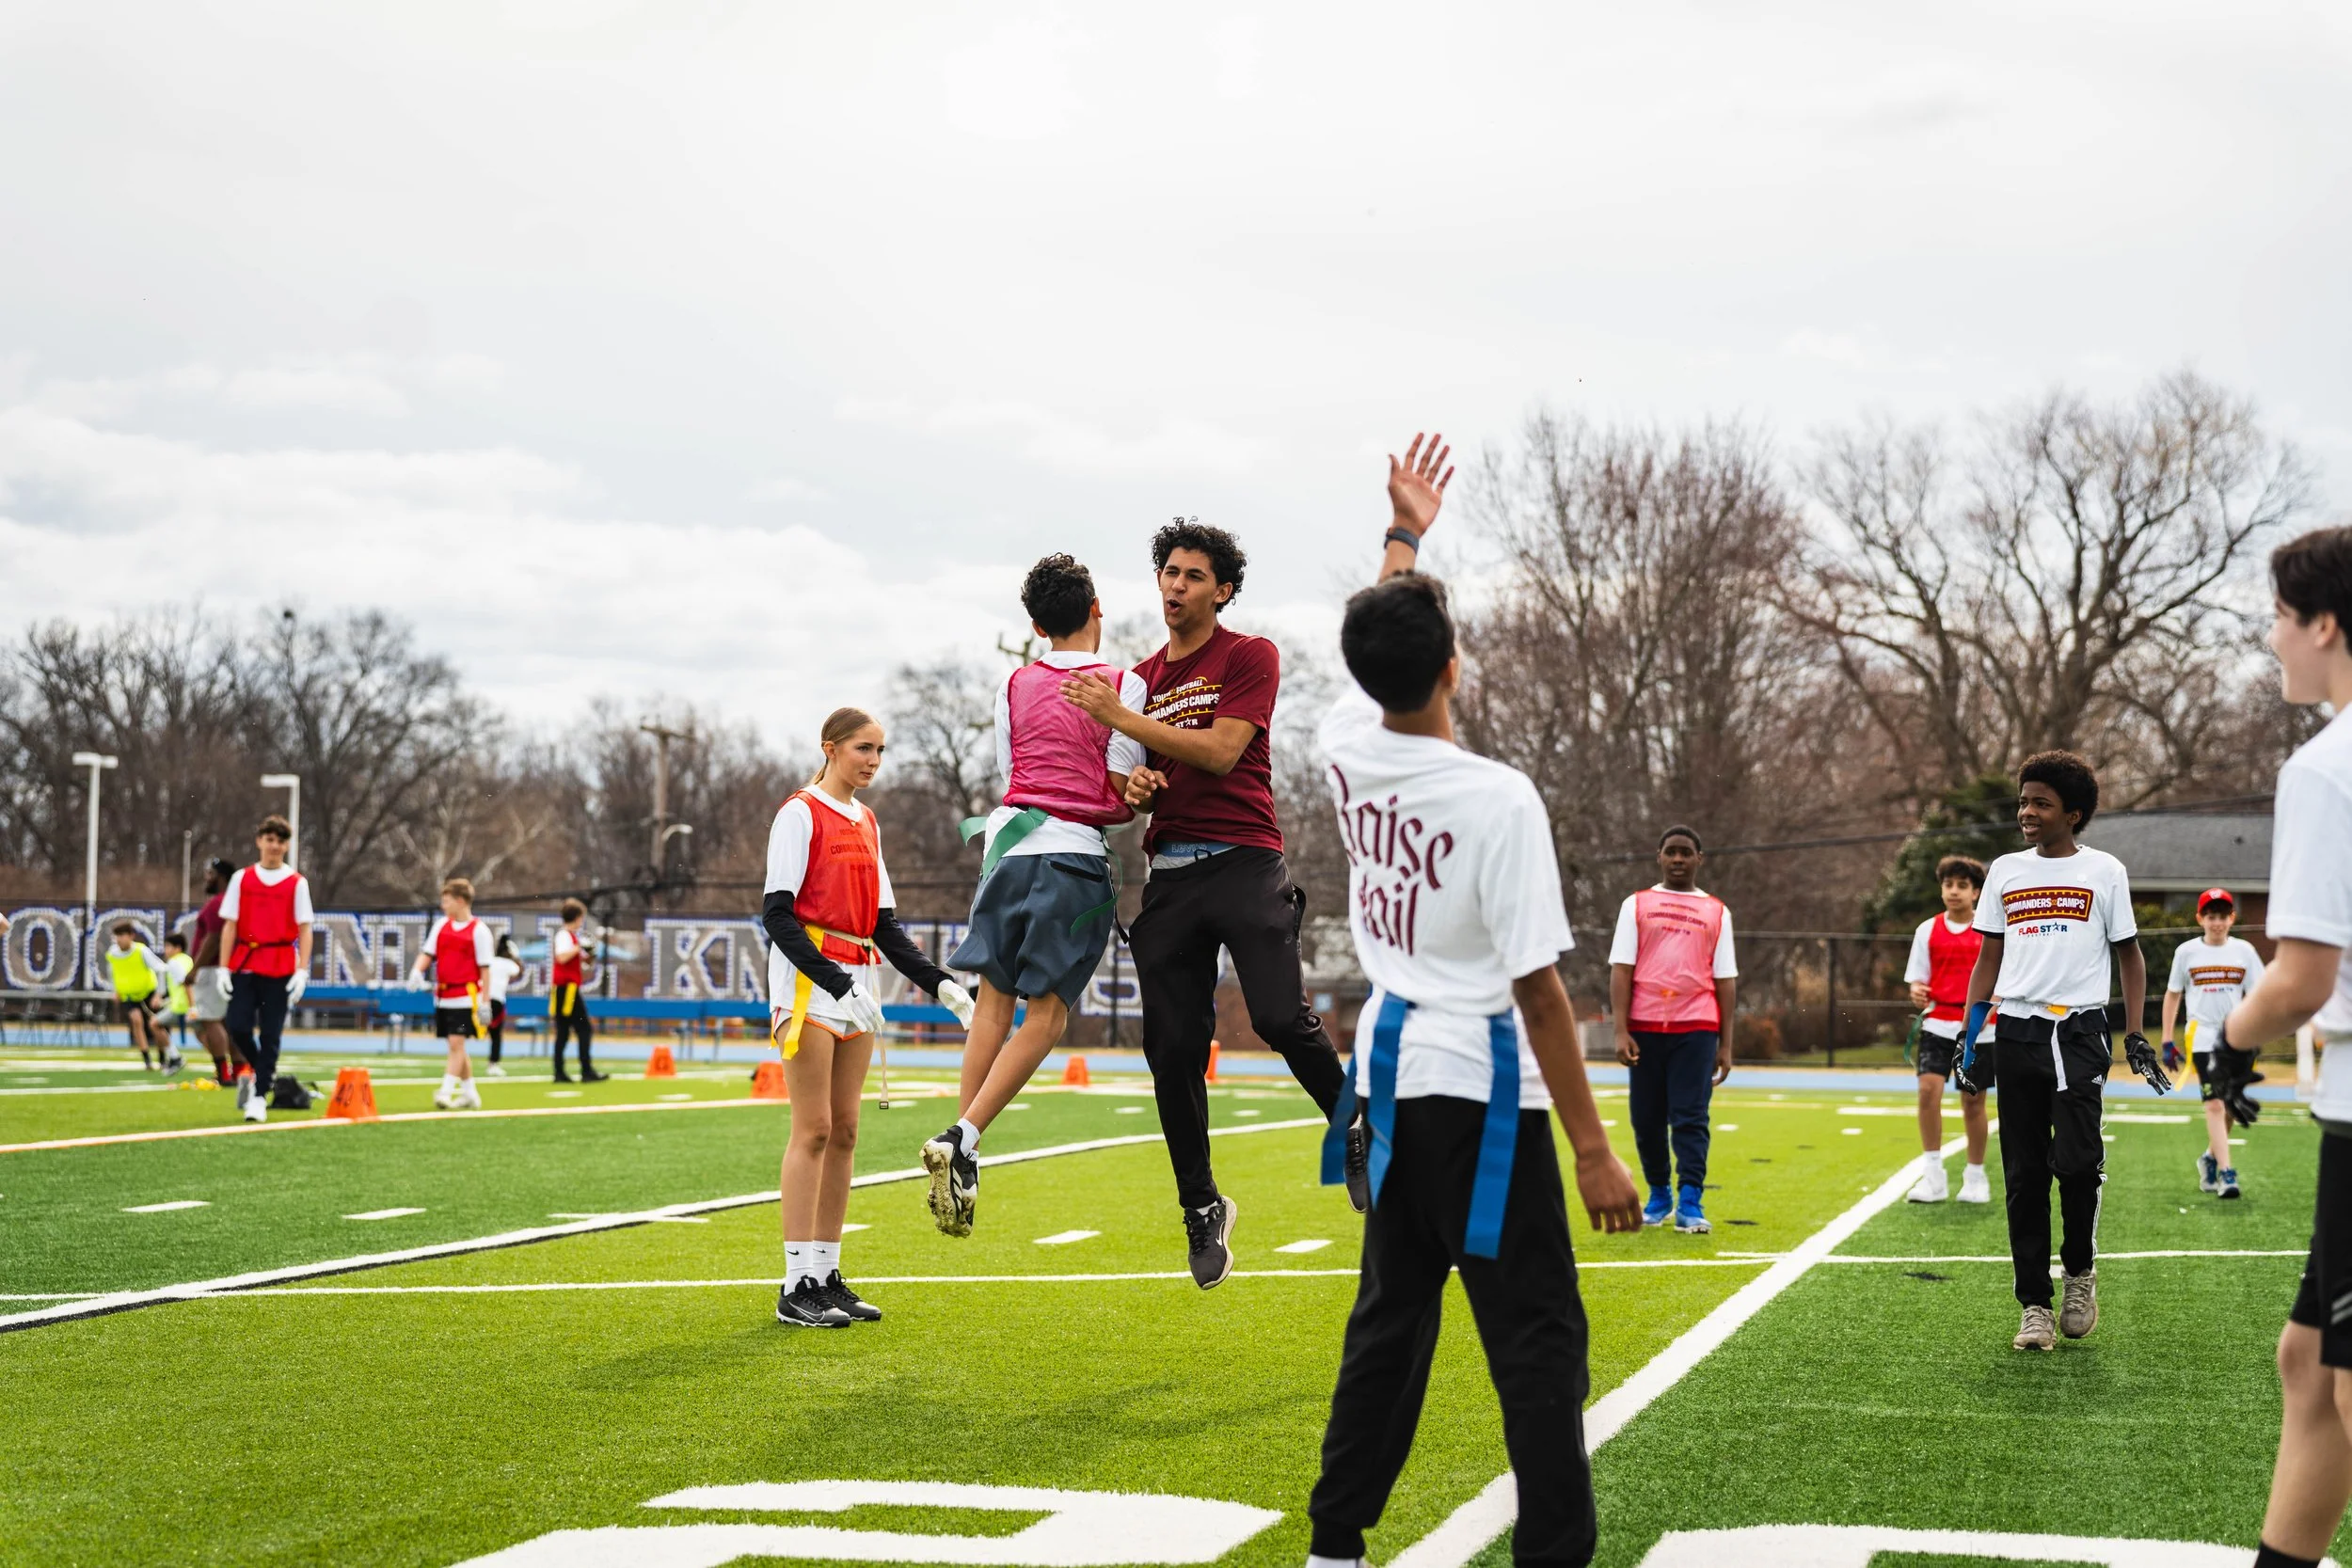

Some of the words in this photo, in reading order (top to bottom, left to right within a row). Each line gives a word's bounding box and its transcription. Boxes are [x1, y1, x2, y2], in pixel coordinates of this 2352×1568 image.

[1189, 693, 1220, 706] CAMPS
[2057, 896, 2086, 911] CAMPS
[2018, 926, 2039, 936] FLAG
